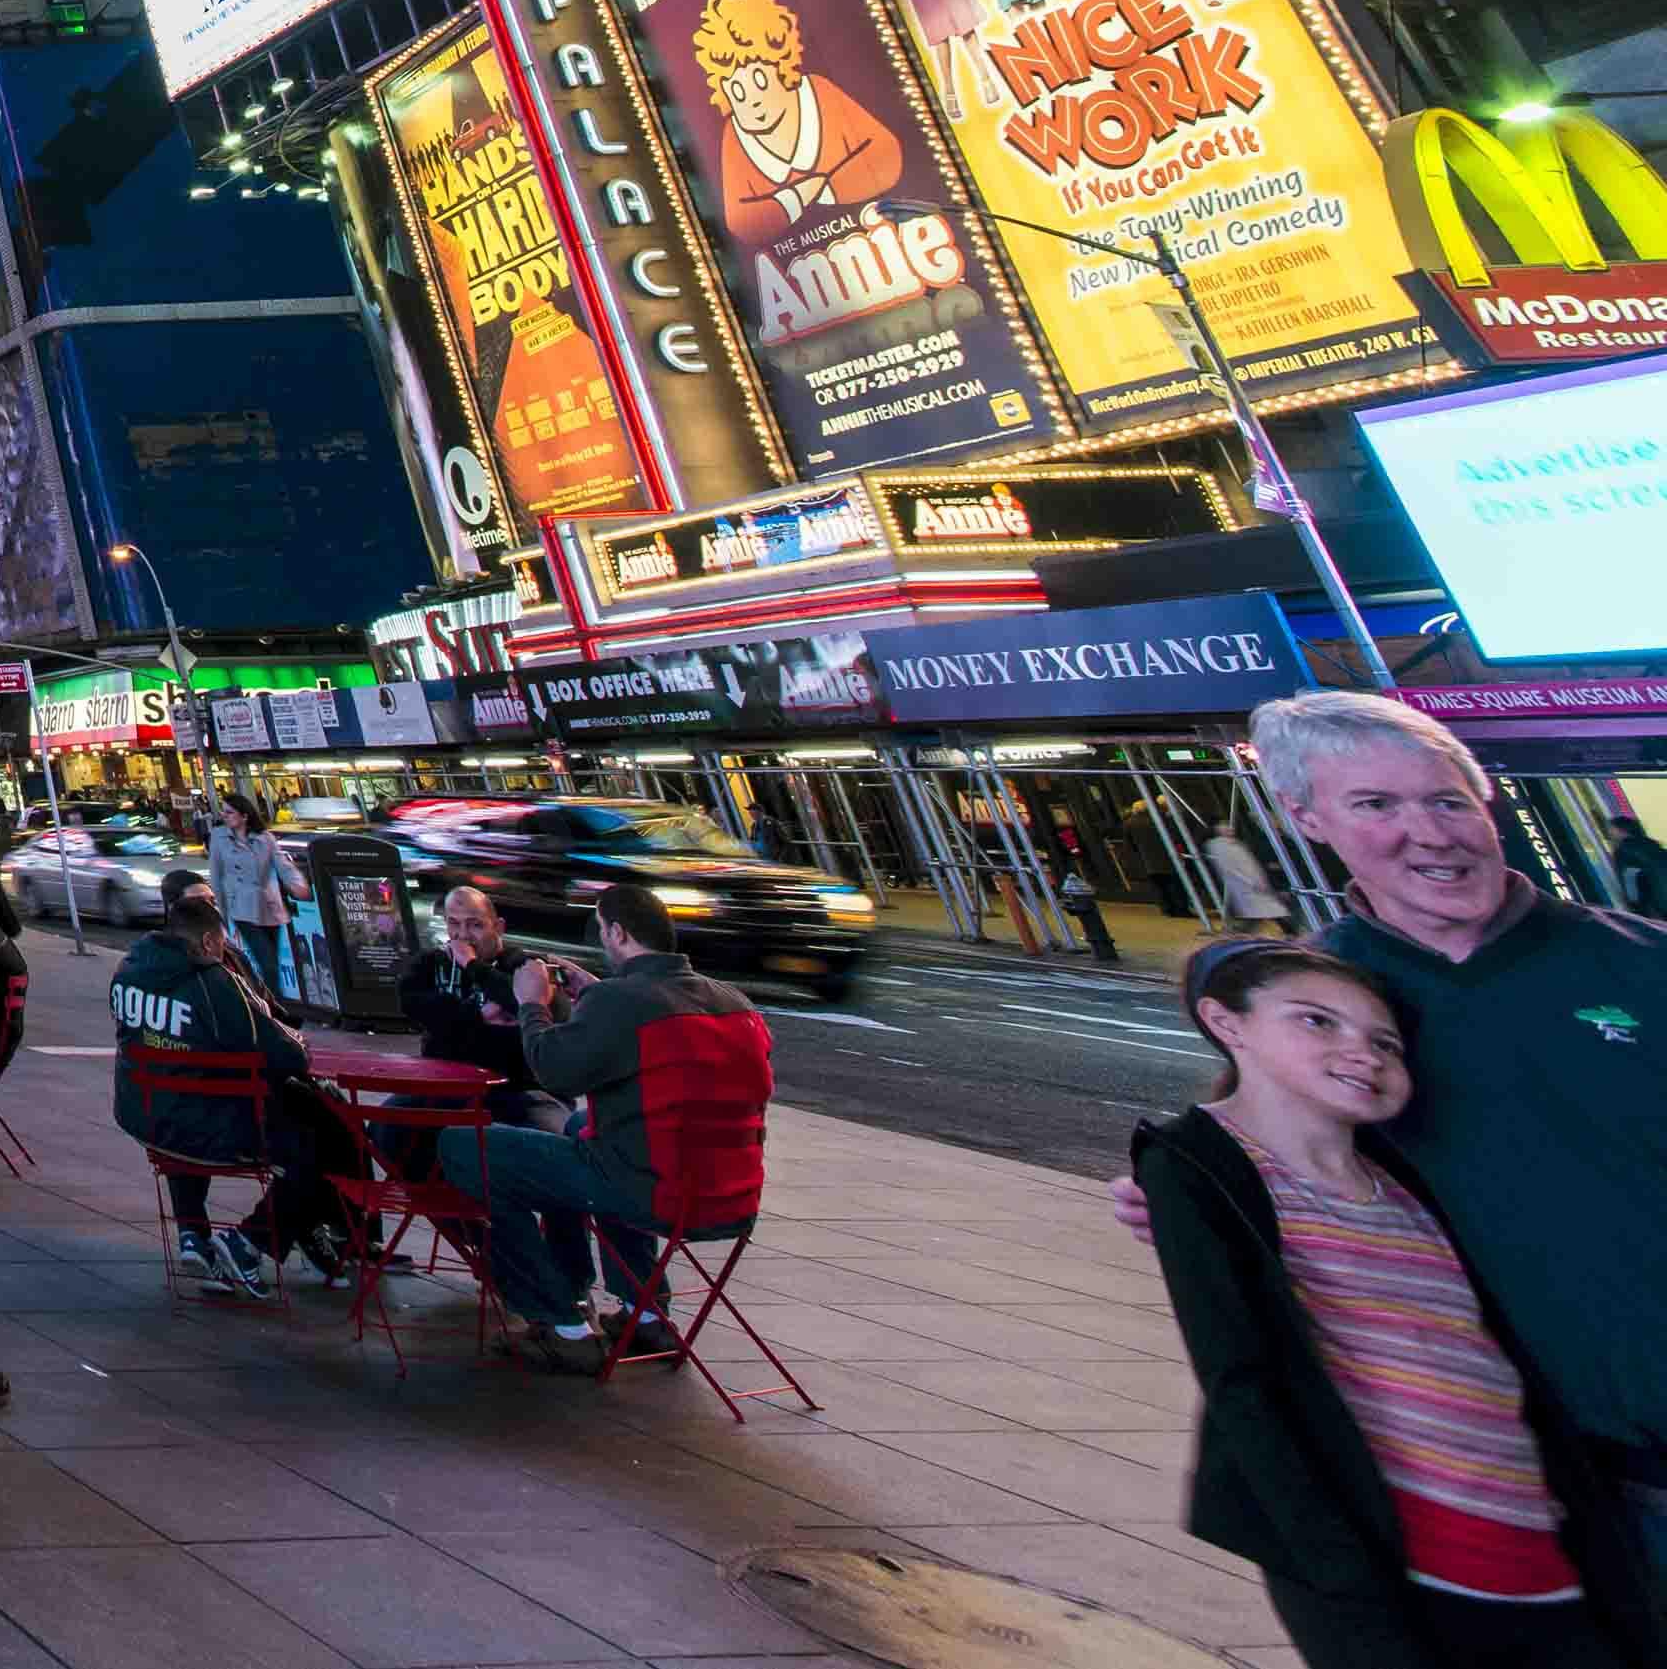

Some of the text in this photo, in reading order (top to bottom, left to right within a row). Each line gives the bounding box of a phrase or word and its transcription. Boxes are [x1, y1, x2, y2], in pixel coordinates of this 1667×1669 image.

[1003, 25, 1267, 177] WORK
[422, 130, 531, 219] HANDS
[1060, 125, 1261, 214] If You Can Get It
[454, 176, 558, 276] HARD
[1120, 169, 1304, 241] Tony-Winning
[774, 214, 857, 258] THE MUSICAL
[1068, 196, 1345, 297] New Comedy
[1234, 243, 1332, 283] IRA GERSHWIN
[468, 250, 572, 327] BODY
[755, 206, 964, 344] Annie
[1235, 295, 1376, 342] KATHLEEN MARSHALL
[806, 330, 961, 388] TICKETMASTER.COM
[816, 351, 964, 406] OR 877-250-2929
[822, 378, 987, 436] ANNIETHEMUSICAL.COM
[914, 494, 1029, 537] Annie
[619, 544, 676, 581] Annie
[0, 665, 22, 674] STANDING
[884, 633, 1275, 691] MONEY EXCHANGE
[36, 685, 130, 733] sbarro sbarro
[473, 665, 714, 727] Annie BOX OFFICE HERE
[1414, 686, 1645, 711] TIMES SQUARE MUSEUM
[339, 882, 364, 891] START
[342, 892, 365, 901] YOUR
[347, 913, 368, 922] HERE
